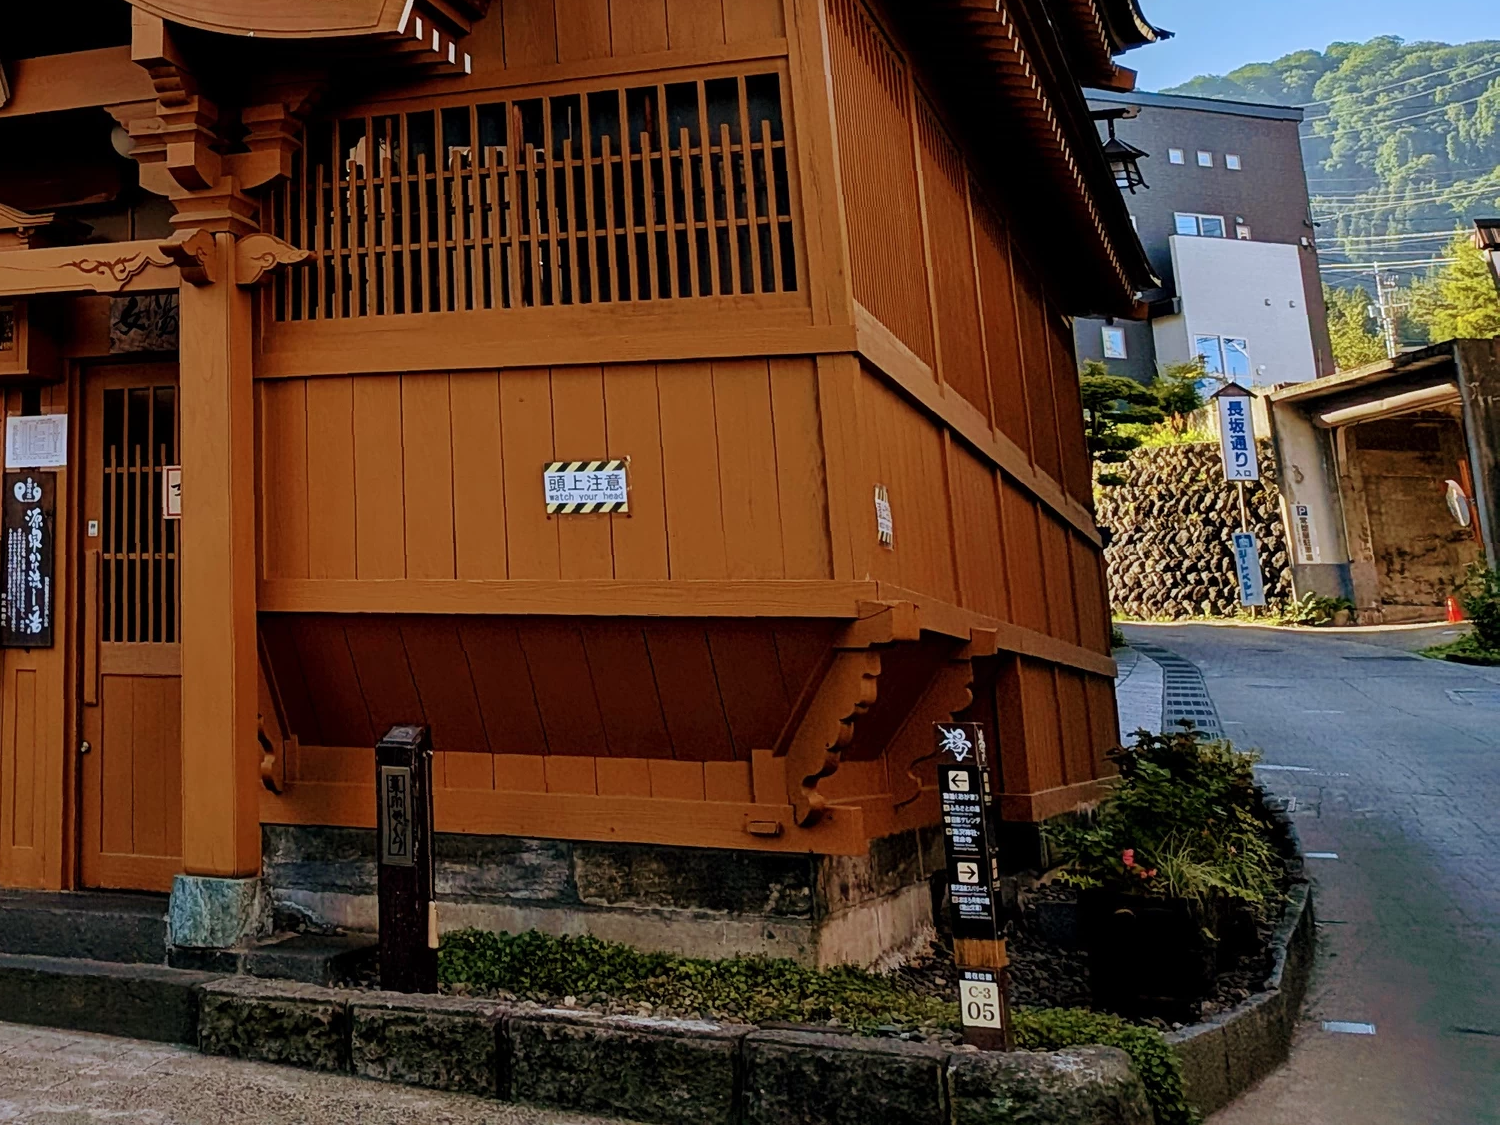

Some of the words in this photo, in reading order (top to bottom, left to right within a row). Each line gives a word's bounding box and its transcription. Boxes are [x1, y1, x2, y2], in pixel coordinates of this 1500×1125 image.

[1227, 400, 1249, 468] 長坂通り
[1235, 469, 1252, 477] 入口
[547, 473, 623, 492] 頭上注意
[549, 492, 575, 501] watch
[579, 493, 598, 501] your
[603, 491, 624, 500] head
[968, 985, 992, 1000] C-3
[967, 1001, 995, 1022] 05
